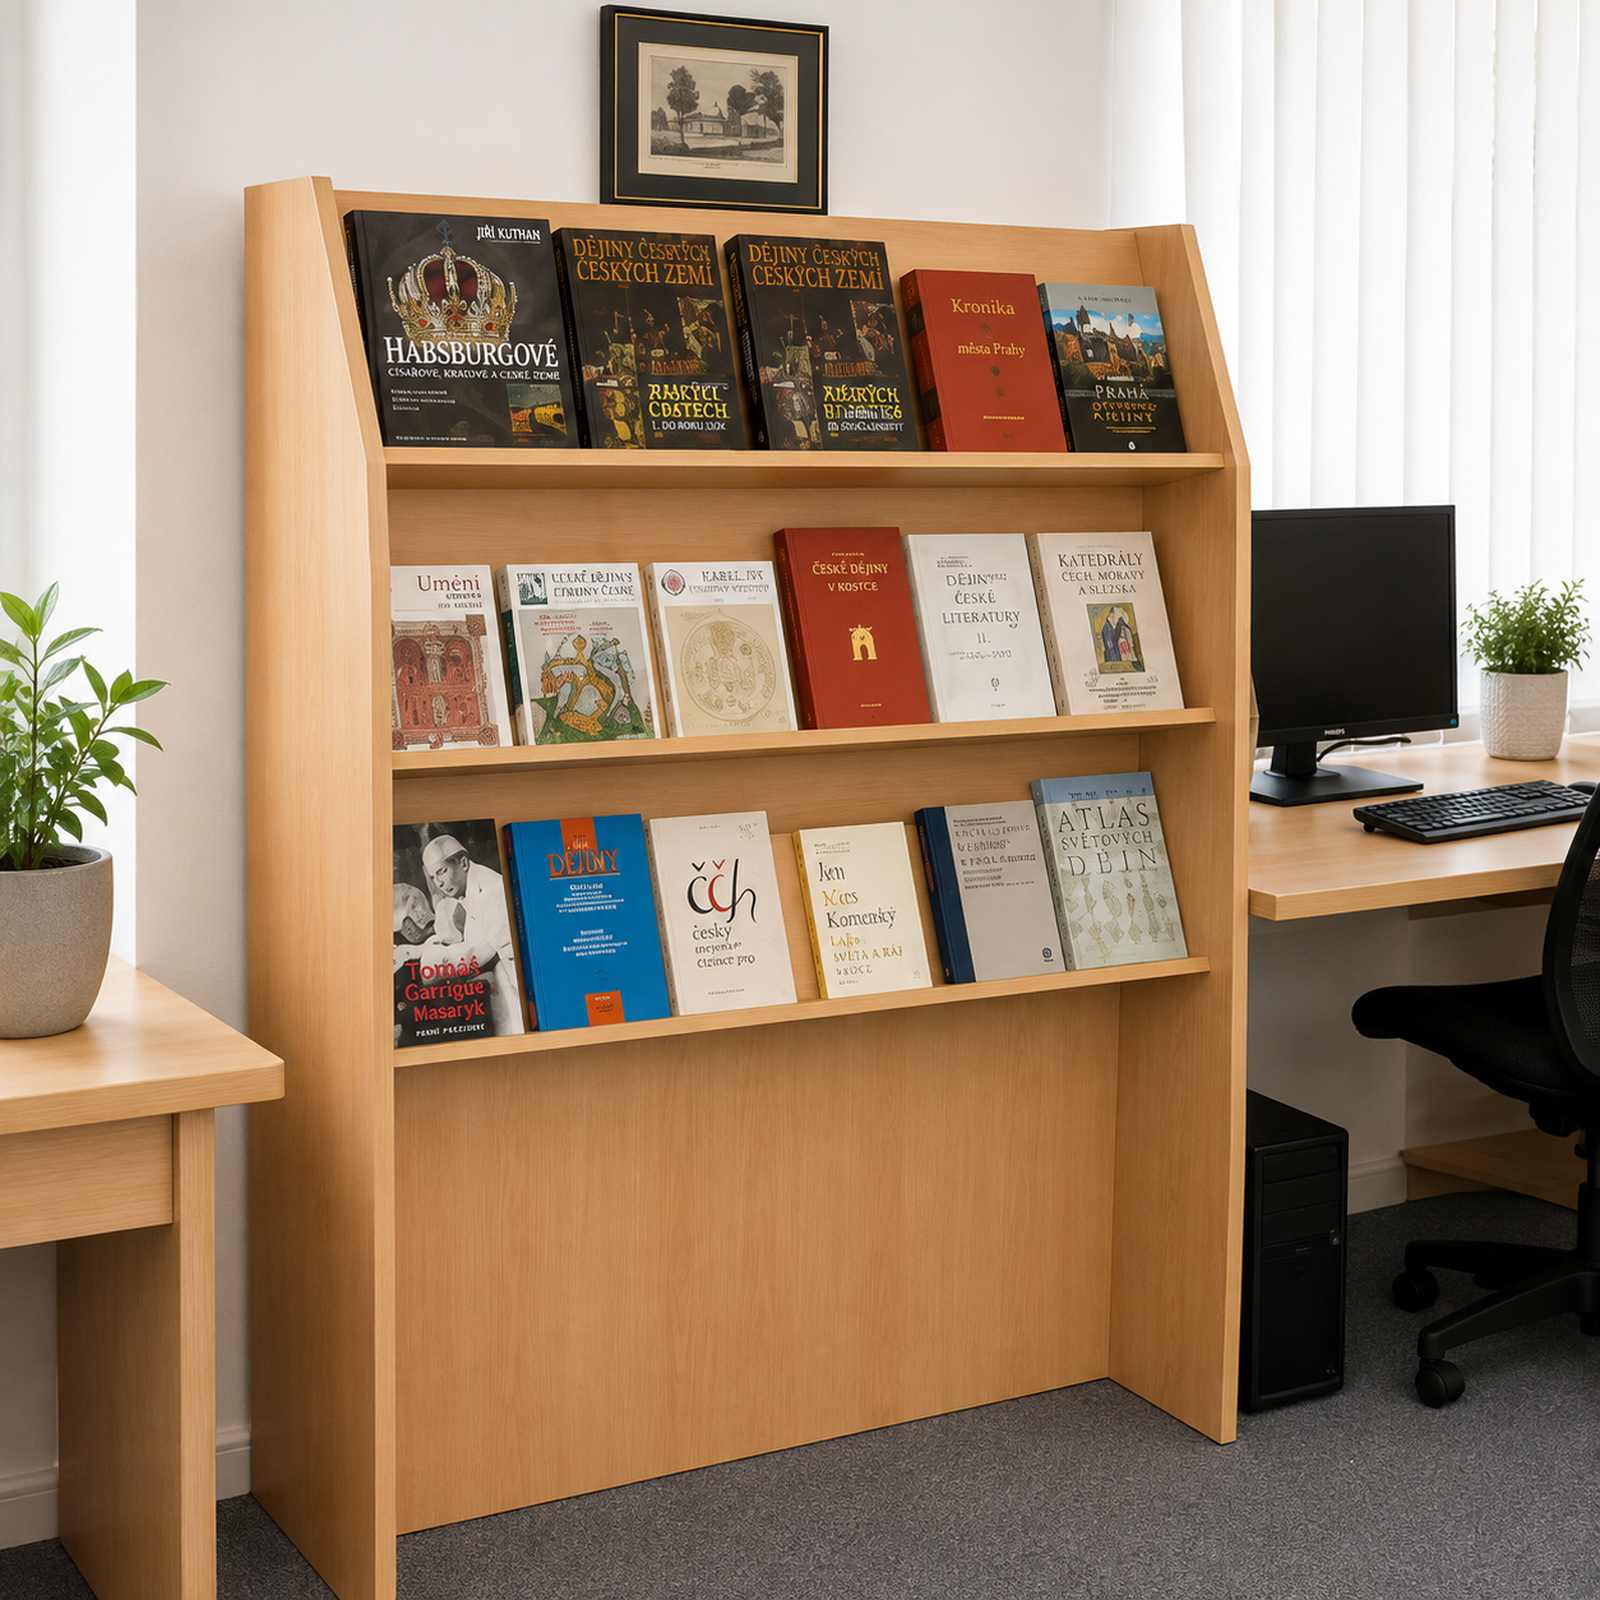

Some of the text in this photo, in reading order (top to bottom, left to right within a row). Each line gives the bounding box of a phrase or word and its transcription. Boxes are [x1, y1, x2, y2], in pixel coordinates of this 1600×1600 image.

[498, 228, 541, 241] KUTHAN
[576, 257, 714, 286] ČESKÝCH ZEMÍ
[951, 298, 1016, 316] Kronika
[384, 336, 559, 367] HABSBURGOVÉ
[958, 342, 1025, 358] města Prahy
[812, 560, 888, 576] ČESKÉ DĚJINY
[1058, 550, 1144, 568] KATEDRÁLY
[827, 581, 879, 592] V KOSTCE
[942, 611, 1020, 629] LITERATURY
[1059, 802, 1150, 833] ATLAS
[404, 955, 481, 980] Tomáš
[404, 981, 485, 1001] Garrigue
[414, 1000, 486, 1022] Masaryk
